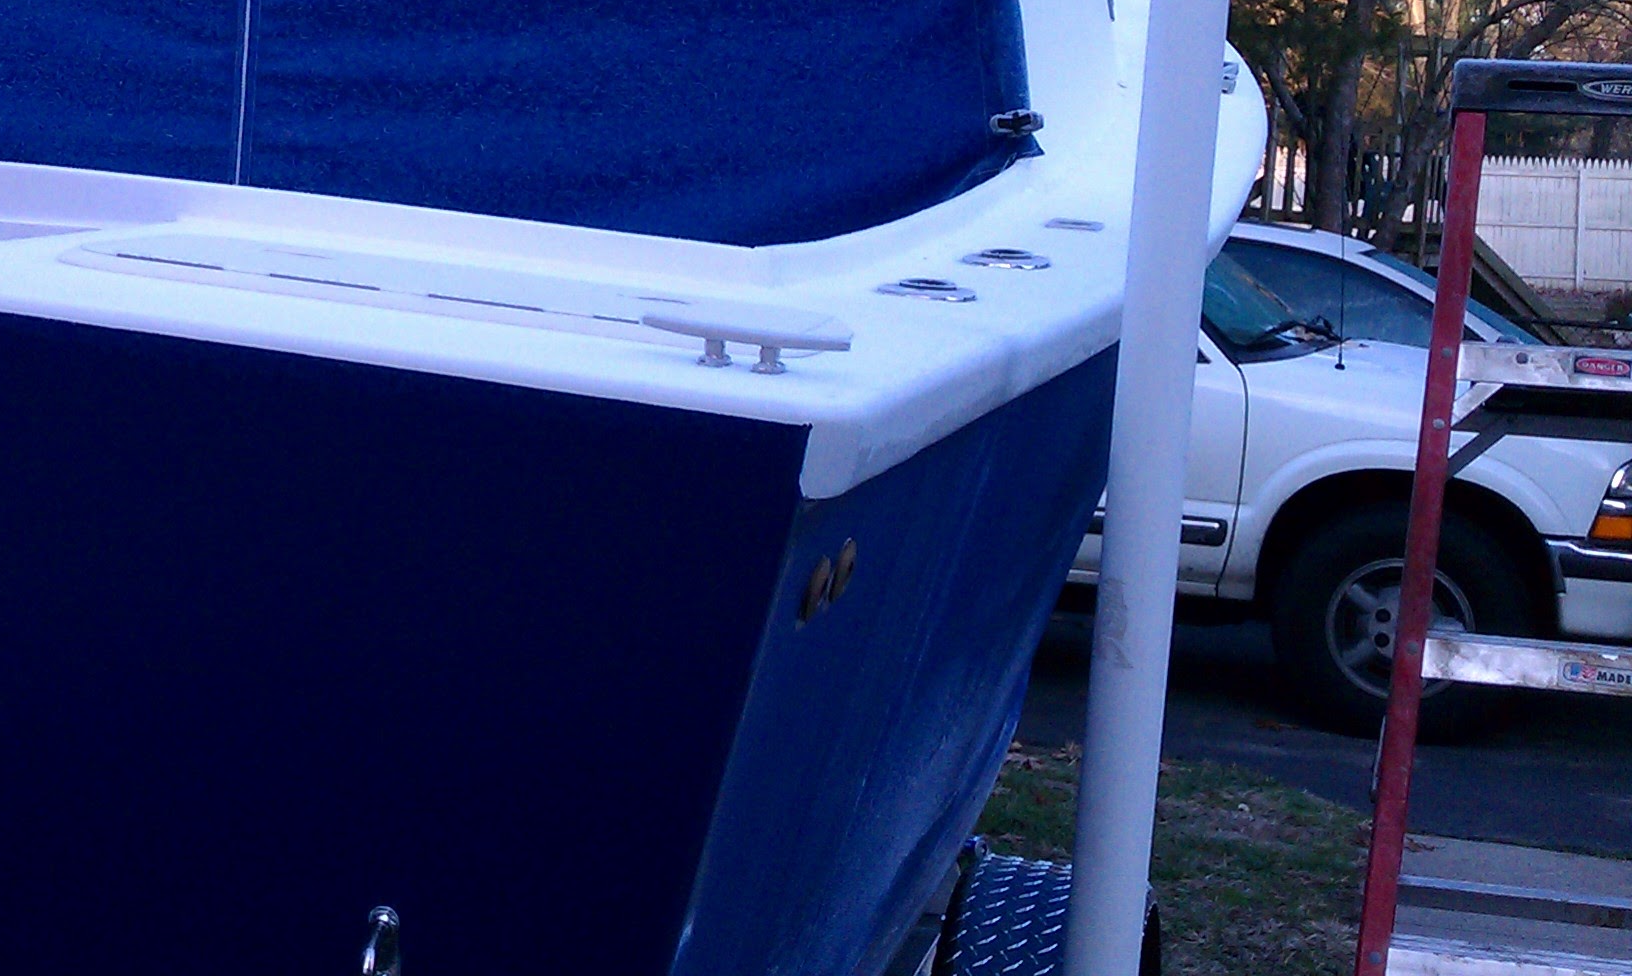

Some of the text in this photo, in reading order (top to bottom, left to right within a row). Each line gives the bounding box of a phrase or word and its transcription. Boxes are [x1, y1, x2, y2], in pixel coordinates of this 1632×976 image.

[1600, 83, 1632, 95] WER
[1581, 361, 1624, 371] DANGER
[1596, 670, 1631, 684] MADE
